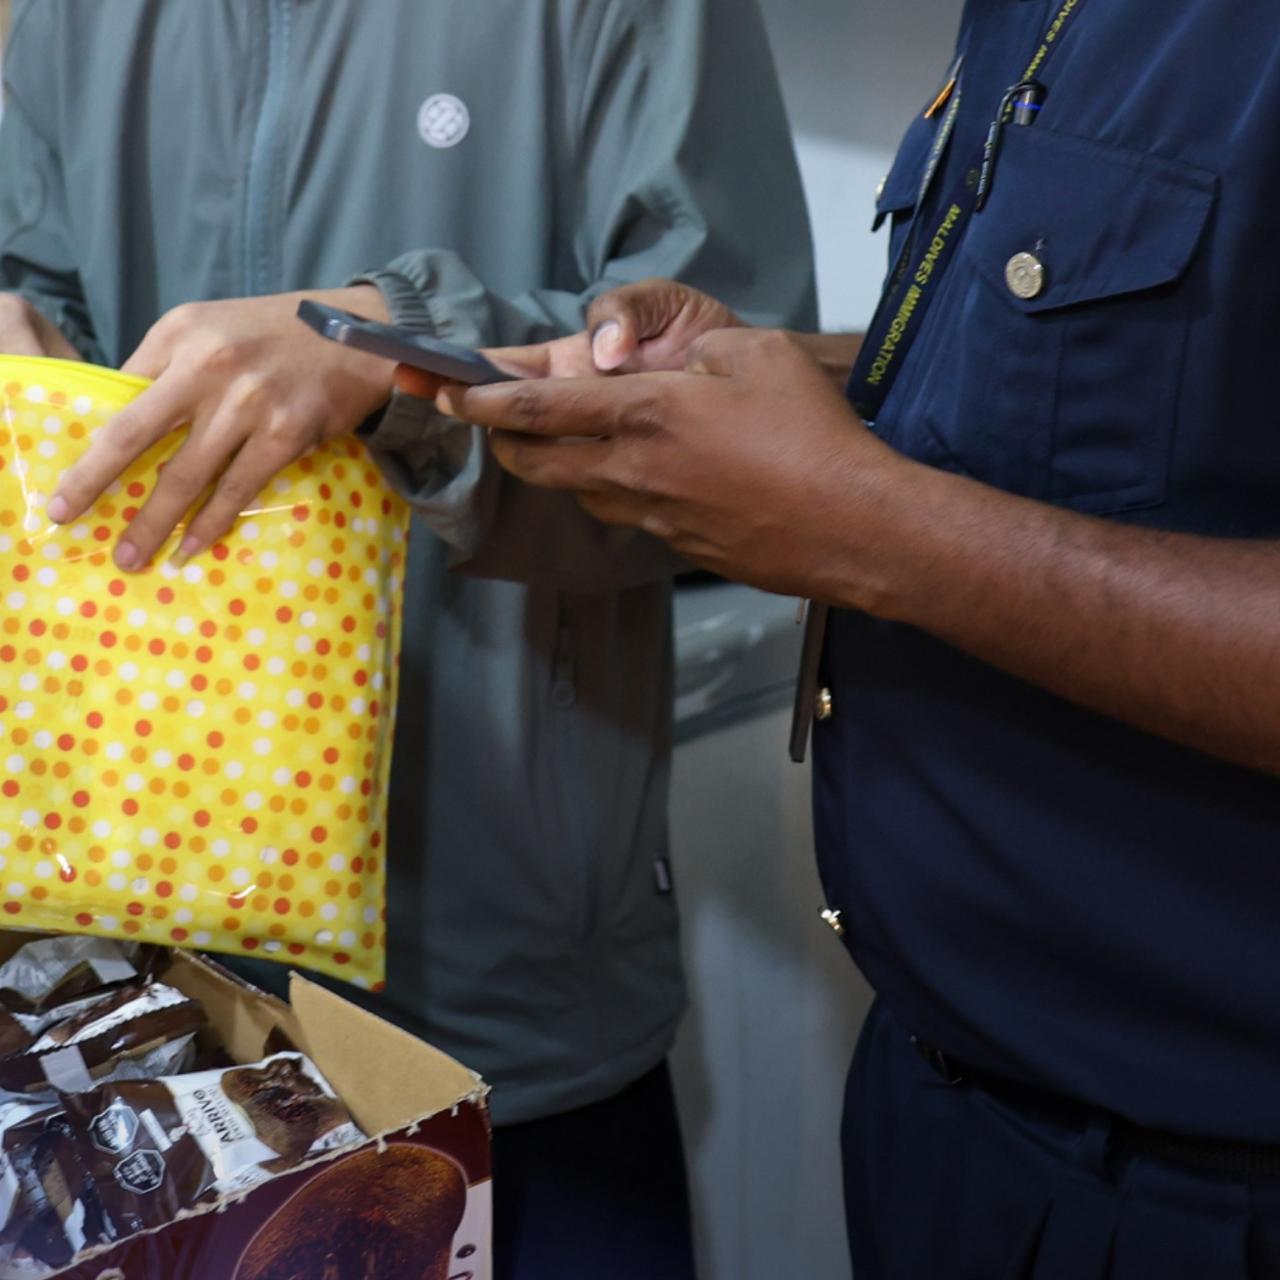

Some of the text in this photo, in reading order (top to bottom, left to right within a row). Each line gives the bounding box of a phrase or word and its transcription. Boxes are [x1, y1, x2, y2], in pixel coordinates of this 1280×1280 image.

[913, 203, 962, 286] MALDIVES
[866, 284, 923, 386] IMMIGRATION
[193, 1088, 236, 1145] ARRIVO
